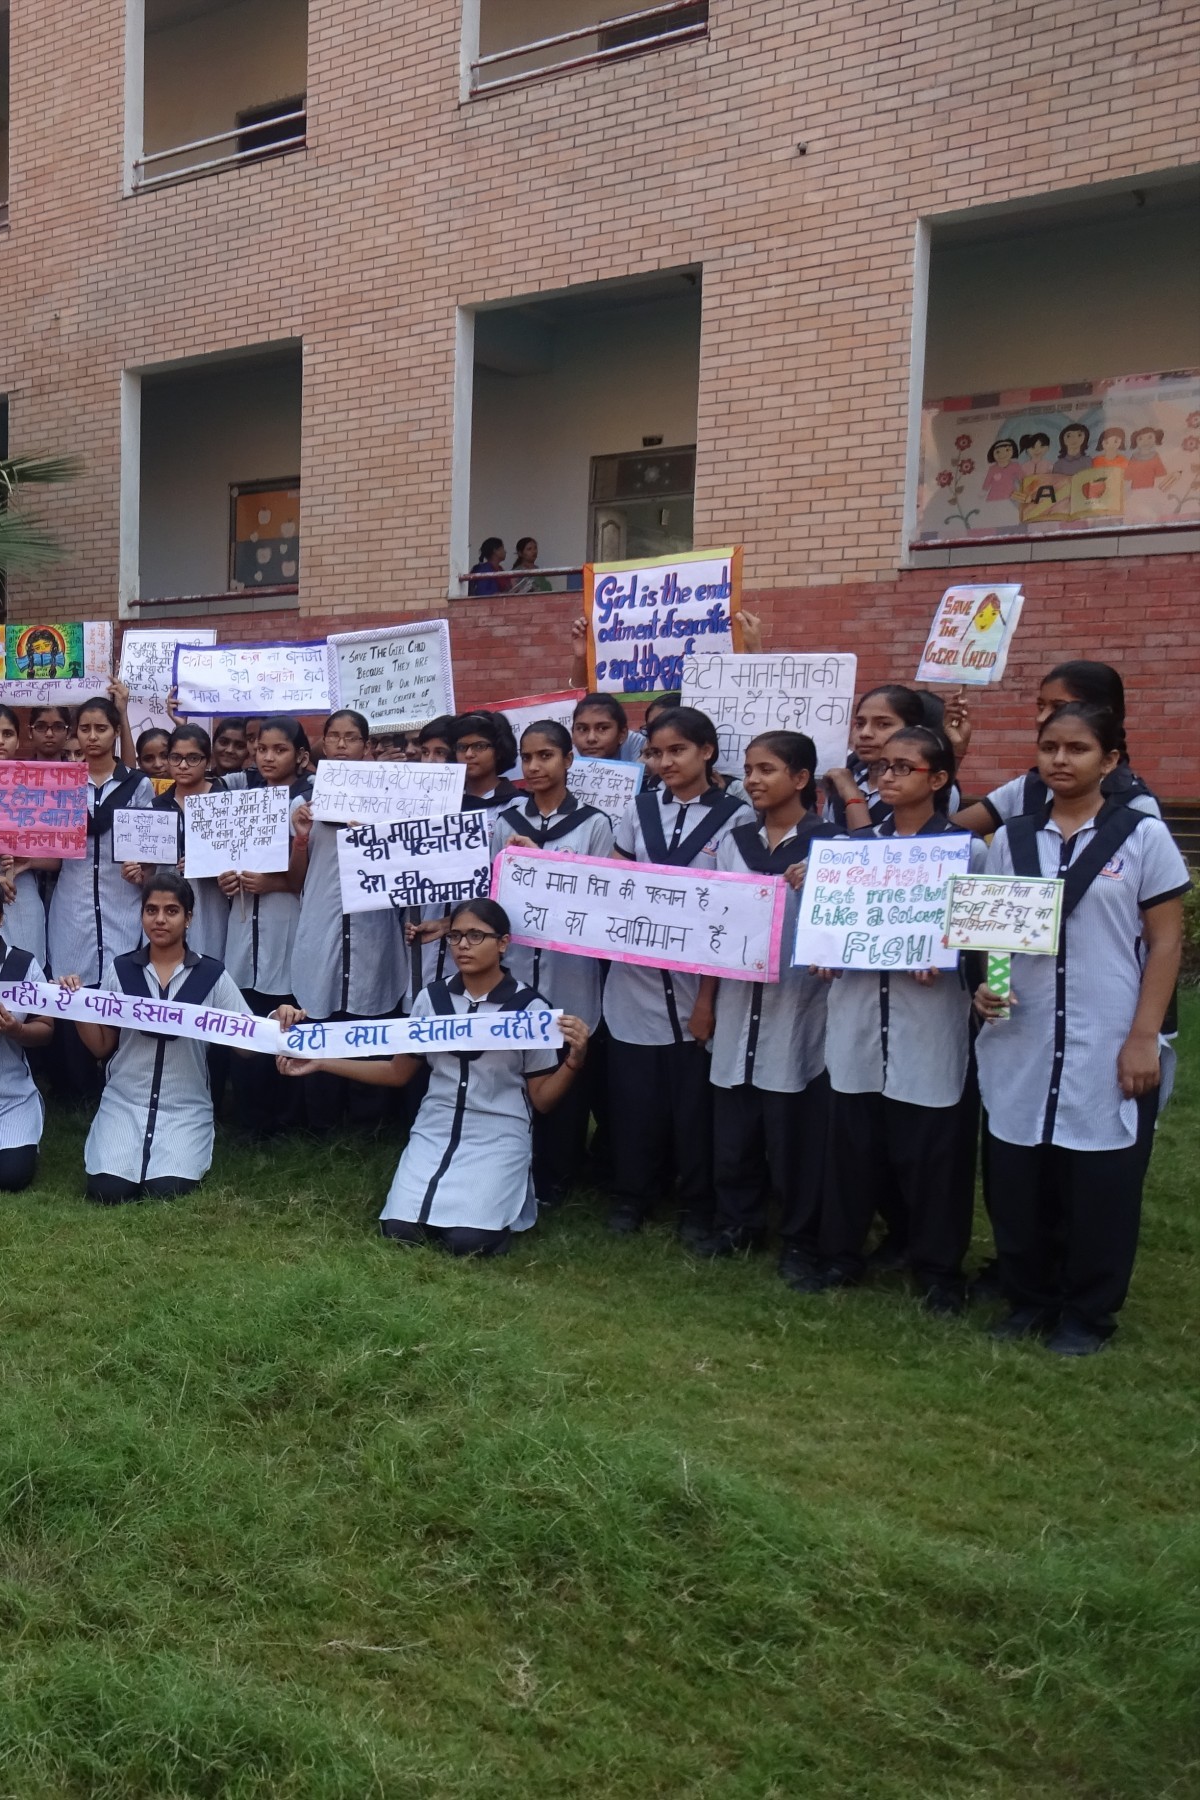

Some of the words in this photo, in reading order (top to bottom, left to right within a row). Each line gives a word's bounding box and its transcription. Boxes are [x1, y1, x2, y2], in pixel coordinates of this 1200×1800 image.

[1035, 484, 1057, 504] A
[595, 575, 638, 623] Girl
[639, 585, 659, 607] is
[660, 572, 693, 606] the
[942, 595, 975, 616] SAVE
[939, 618, 959, 637] THE
[370, 646, 388, 660] THE
[609, 643, 639, 680] and
[924, 641, 959, 665] GIRL
[962, 640, 998, 669] CHILD
[682, 654, 733, 689] बेटी
[812, 657, 846, 689] की
[776, 690, 813, 729] देश
[815, 697, 852, 726] का
[323, 763, 350, 787] बेटी
[389, 763, 412, 790] बेटी
[345, 824, 378, 848] बेटी
[363, 838, 390, 861] की
[403, 833, 462, 856] पहचान
[883, 844, 901, 864] be
[357, 869, 386, 894] देश
[473, 866, 490, 898] है
[511, 863, 537, 888] बेटी
[545, 871, 578, 895] माता
[587, 873, 610, 897] पिता
[619, 878, 636, 900] की
[646, 885, 687, 908] पहचान
[866, 887, 905, 905] me
[523, 902, 549, 932] देश
[565, 910, 588, 936] का
[605, 915, 693, 952] स्वाभिमान
[708, 925, 727, 954] है
[867, 906, 885, 927] a
[84, 992, 129, 1018] प्यारे
[132, 998, 186, 1025] इंसान
[194, 1010, 263, 1038] बताओ
[286, 1023, 337, 1051] बेटी
[345, 1024, 395, 1048] क्या
[408, 1016, 487, 1043] संतान
[490, 1010, 553, 1042] नहीं?
